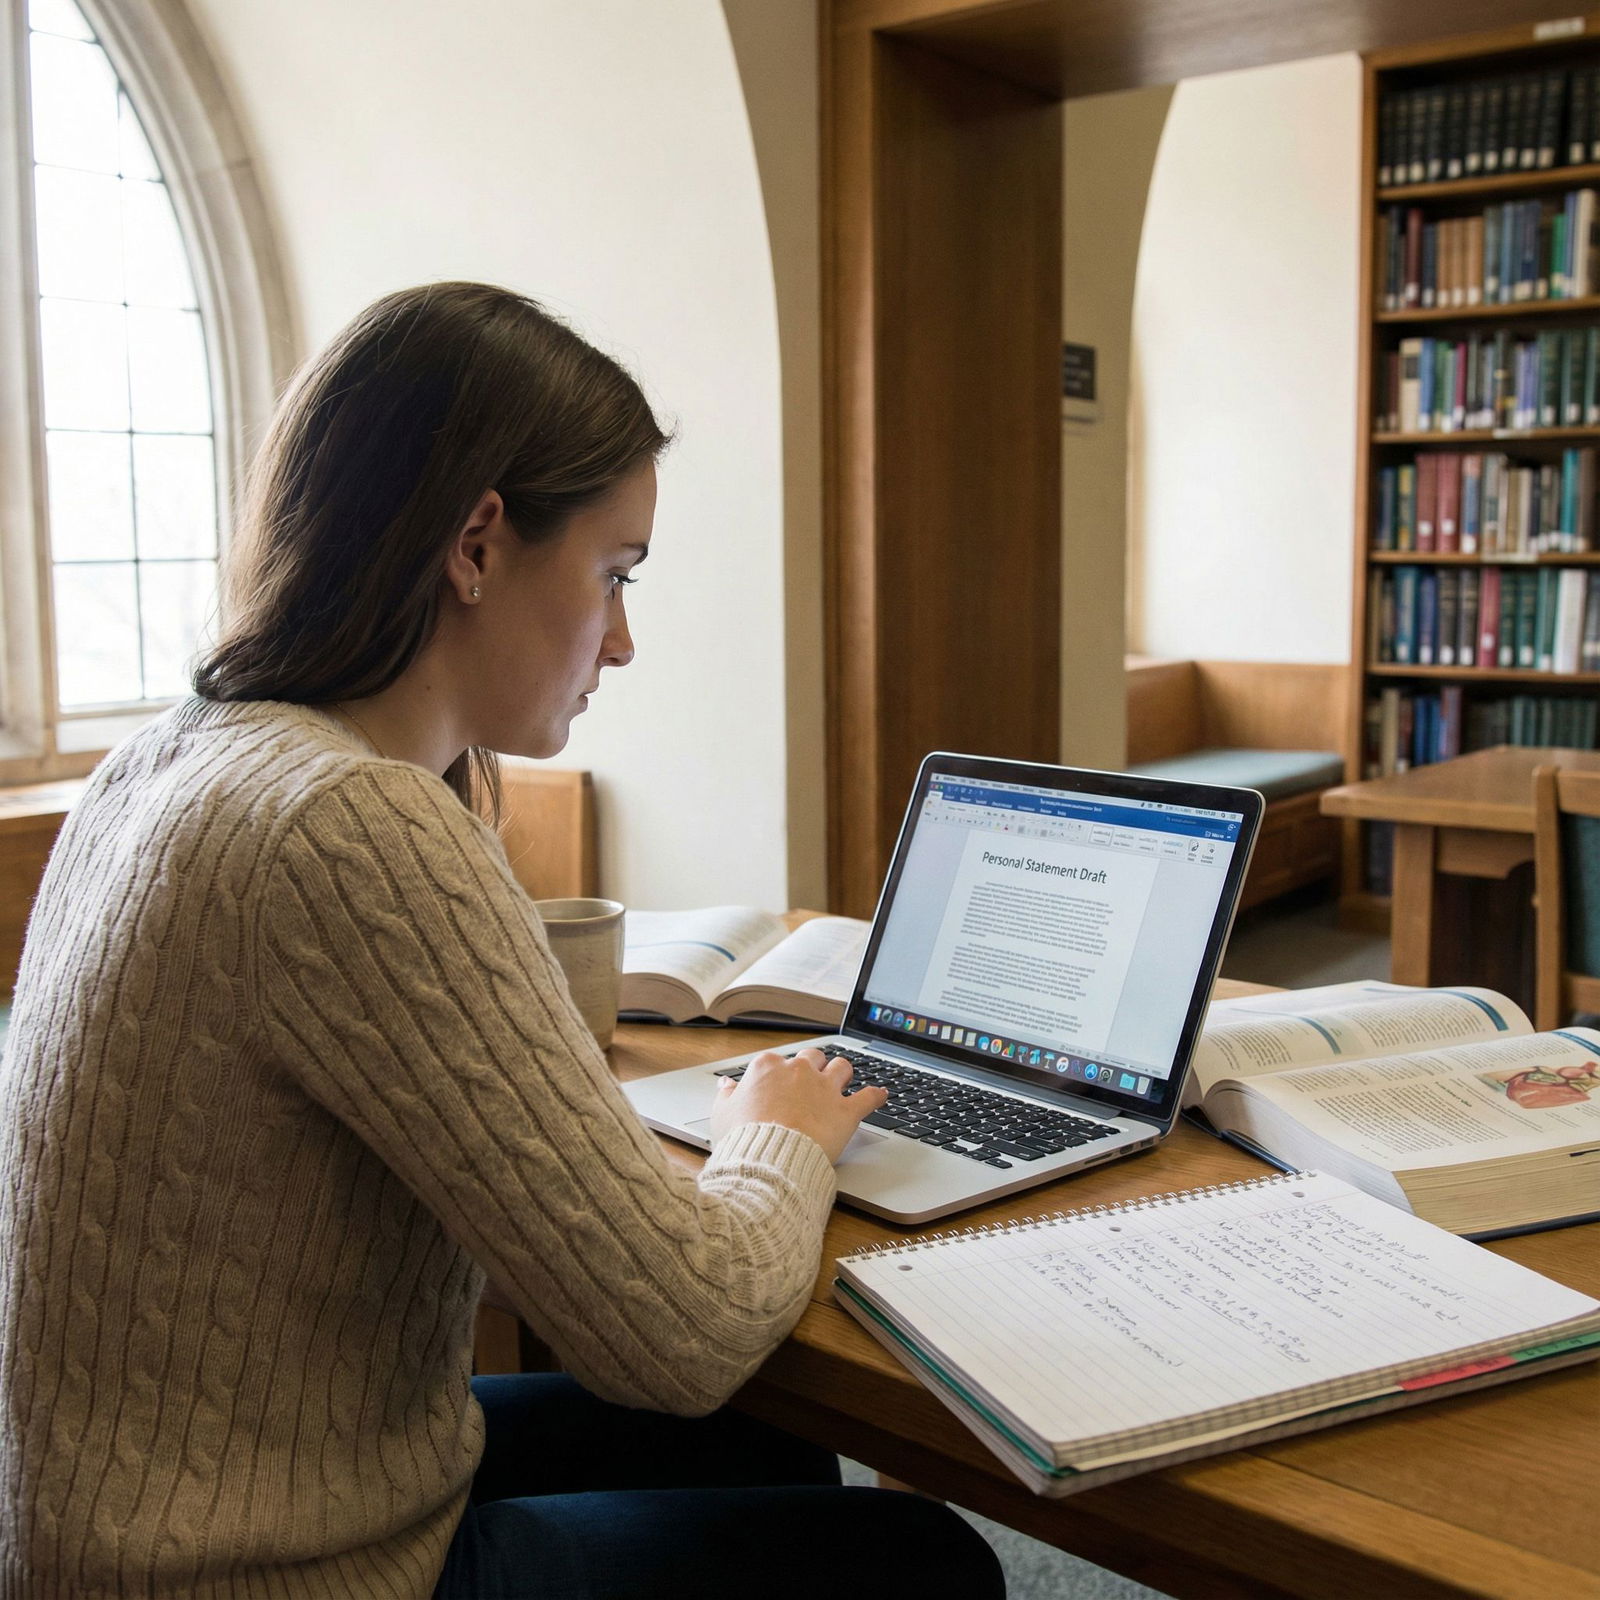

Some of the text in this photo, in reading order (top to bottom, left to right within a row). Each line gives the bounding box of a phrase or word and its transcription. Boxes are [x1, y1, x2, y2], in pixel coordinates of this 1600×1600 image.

[982, 851, 1108, 884] Personal Statement Draft
